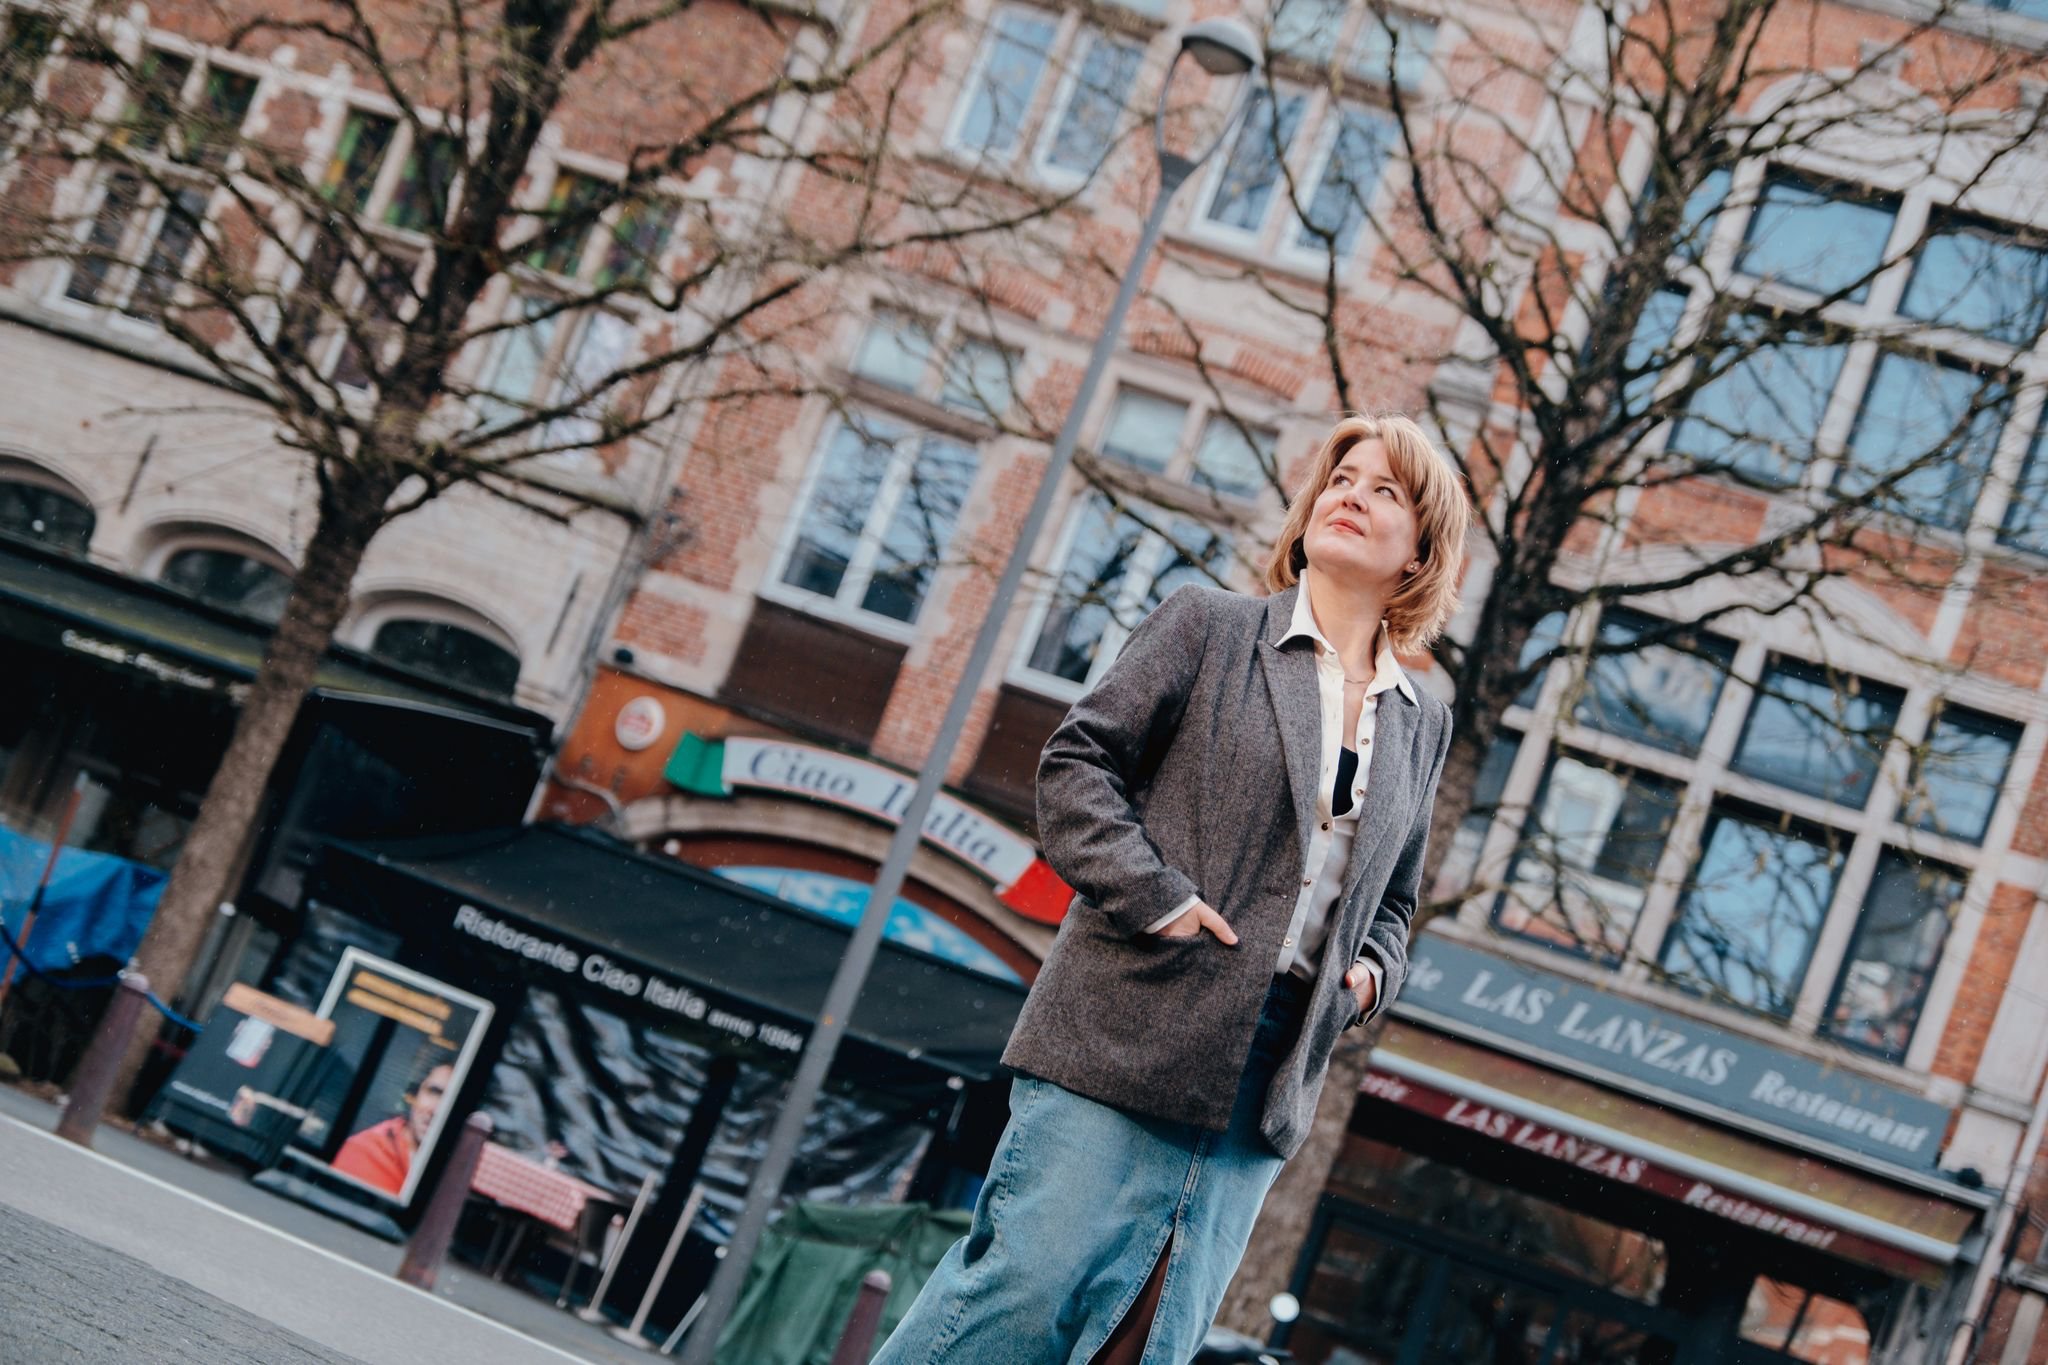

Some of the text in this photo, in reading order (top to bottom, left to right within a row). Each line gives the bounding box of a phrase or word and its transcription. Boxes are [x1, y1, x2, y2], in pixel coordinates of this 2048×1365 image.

[750, 744, 998, 864] Ciao Ilia
[453, 904, 579, 973] Ristorante
[582, 954, 641, 996] Ciao
[643, 976, 706, 1020] Italia
[1461, 969, 1554, 1025] LAS
[1557, 1001, 1738, 1086] LANZAS
[1751, 1070, 1929, 1152] Restaurant
[1445, 1099, 1514, 1138] LAS
[1512, 1122, 1648, 1183] LANZAS
[1682, 1182, 1838, 1249] Restaurant
